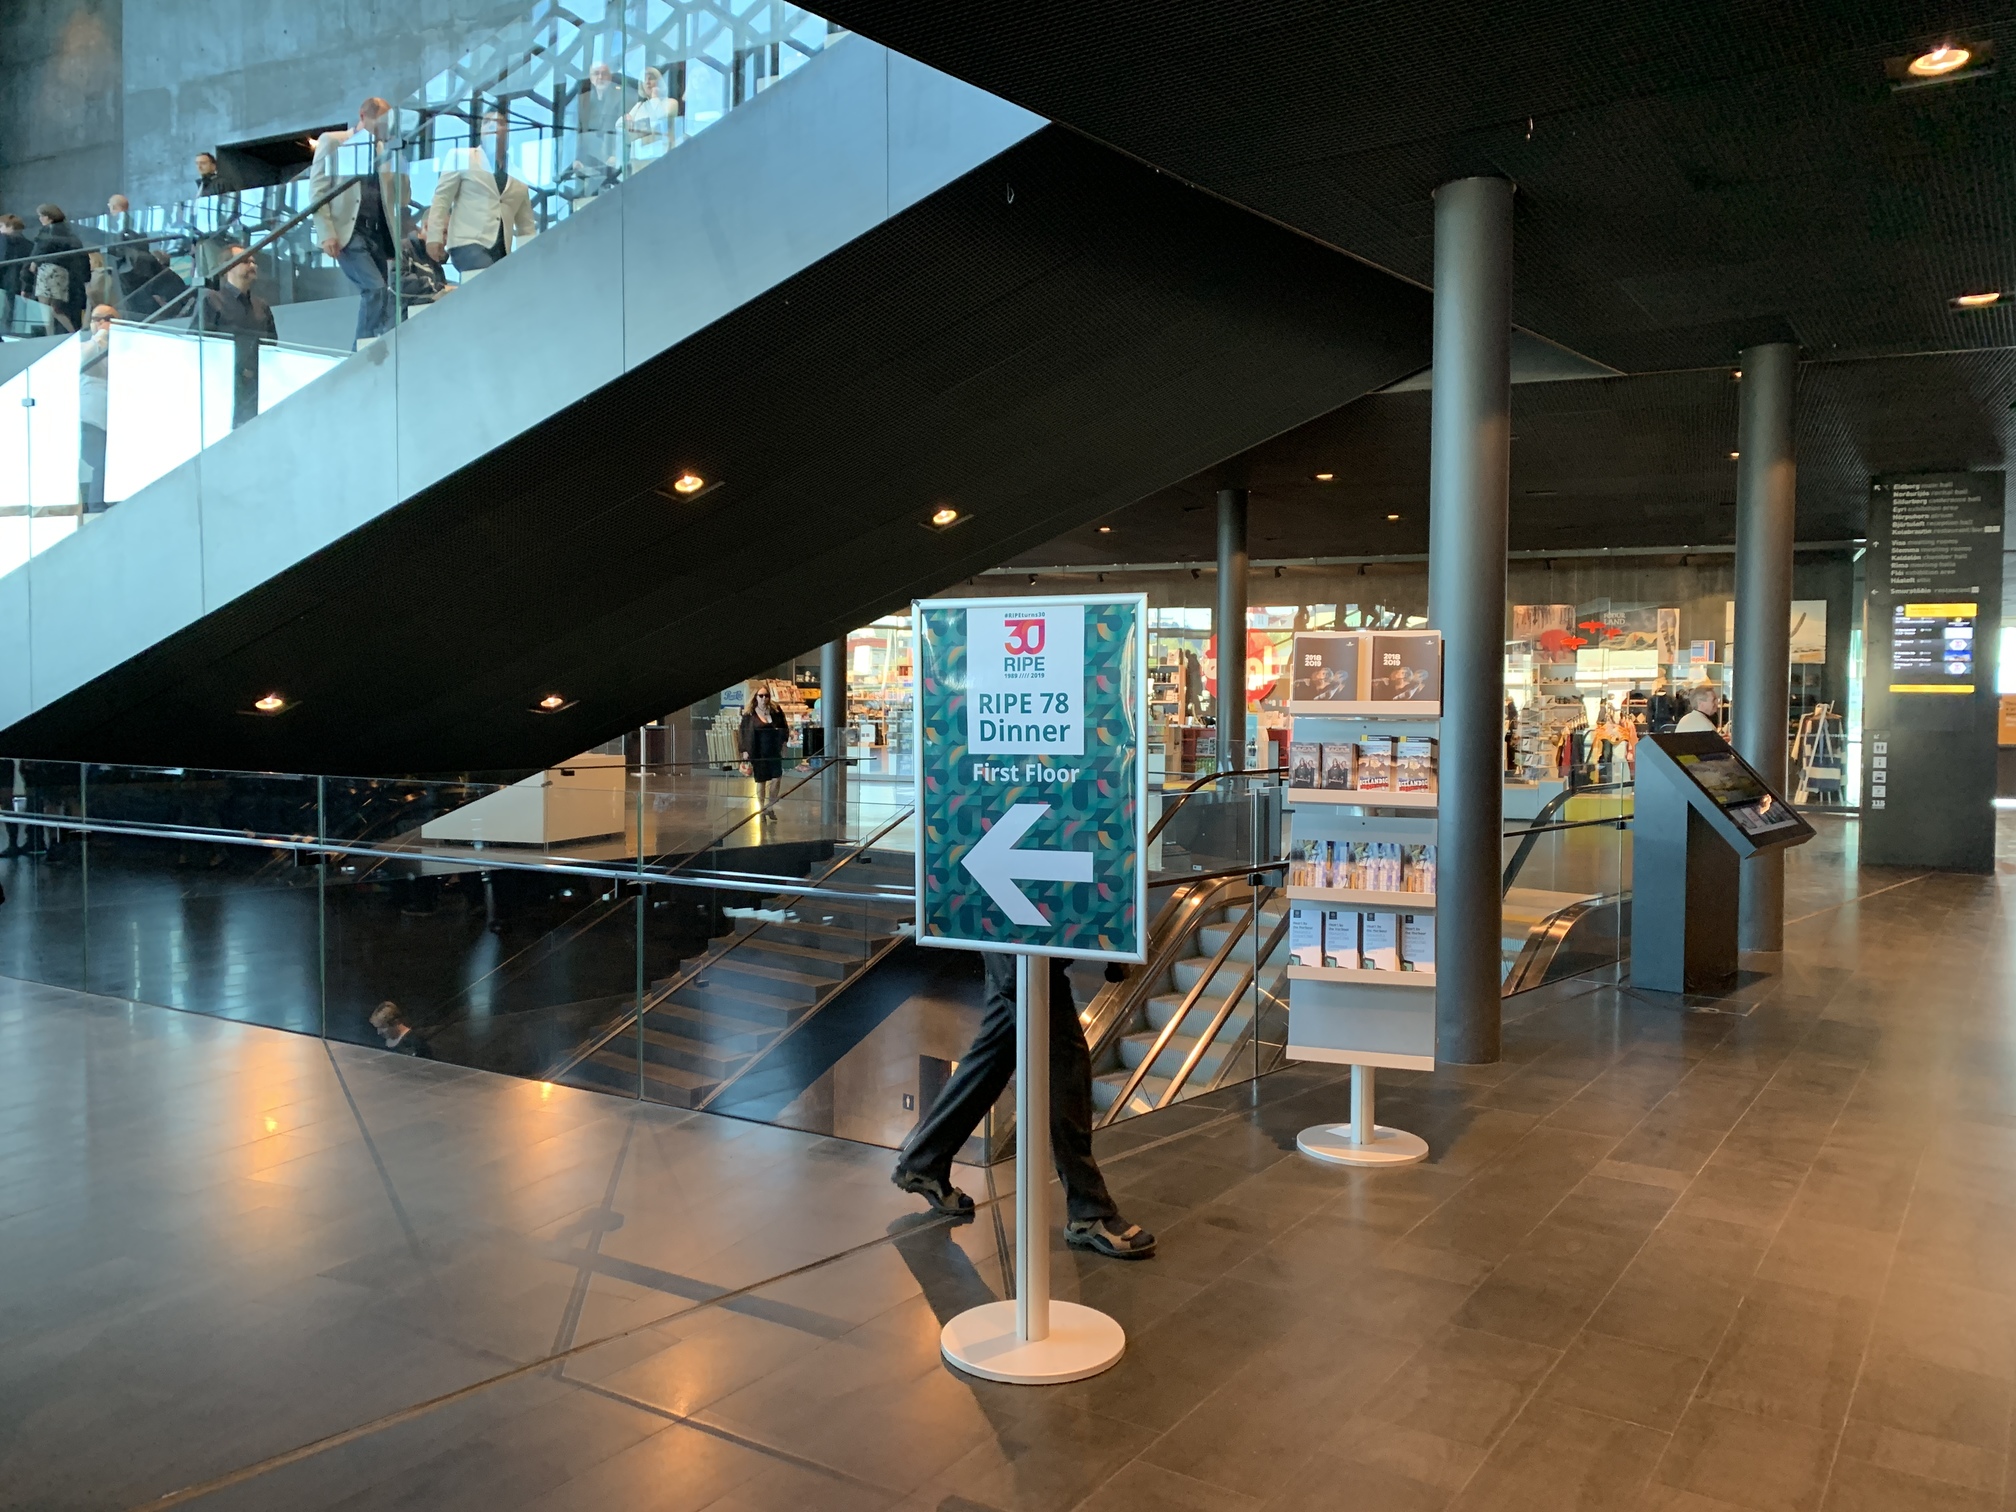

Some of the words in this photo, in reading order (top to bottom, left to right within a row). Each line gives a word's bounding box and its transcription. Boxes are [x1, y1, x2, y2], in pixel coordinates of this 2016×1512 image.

[1004, 618, 1046, 656] 30
[1004, 656, 1045, 672] RIPE
[979, 693, 1032, 714] RIPE
[1039, 692, 1069, 714] 78
[980, 719, 1071, 742] Dinner
[973, 763, 1019, 782] First
[1025, 763, 1080, 783] Floor
